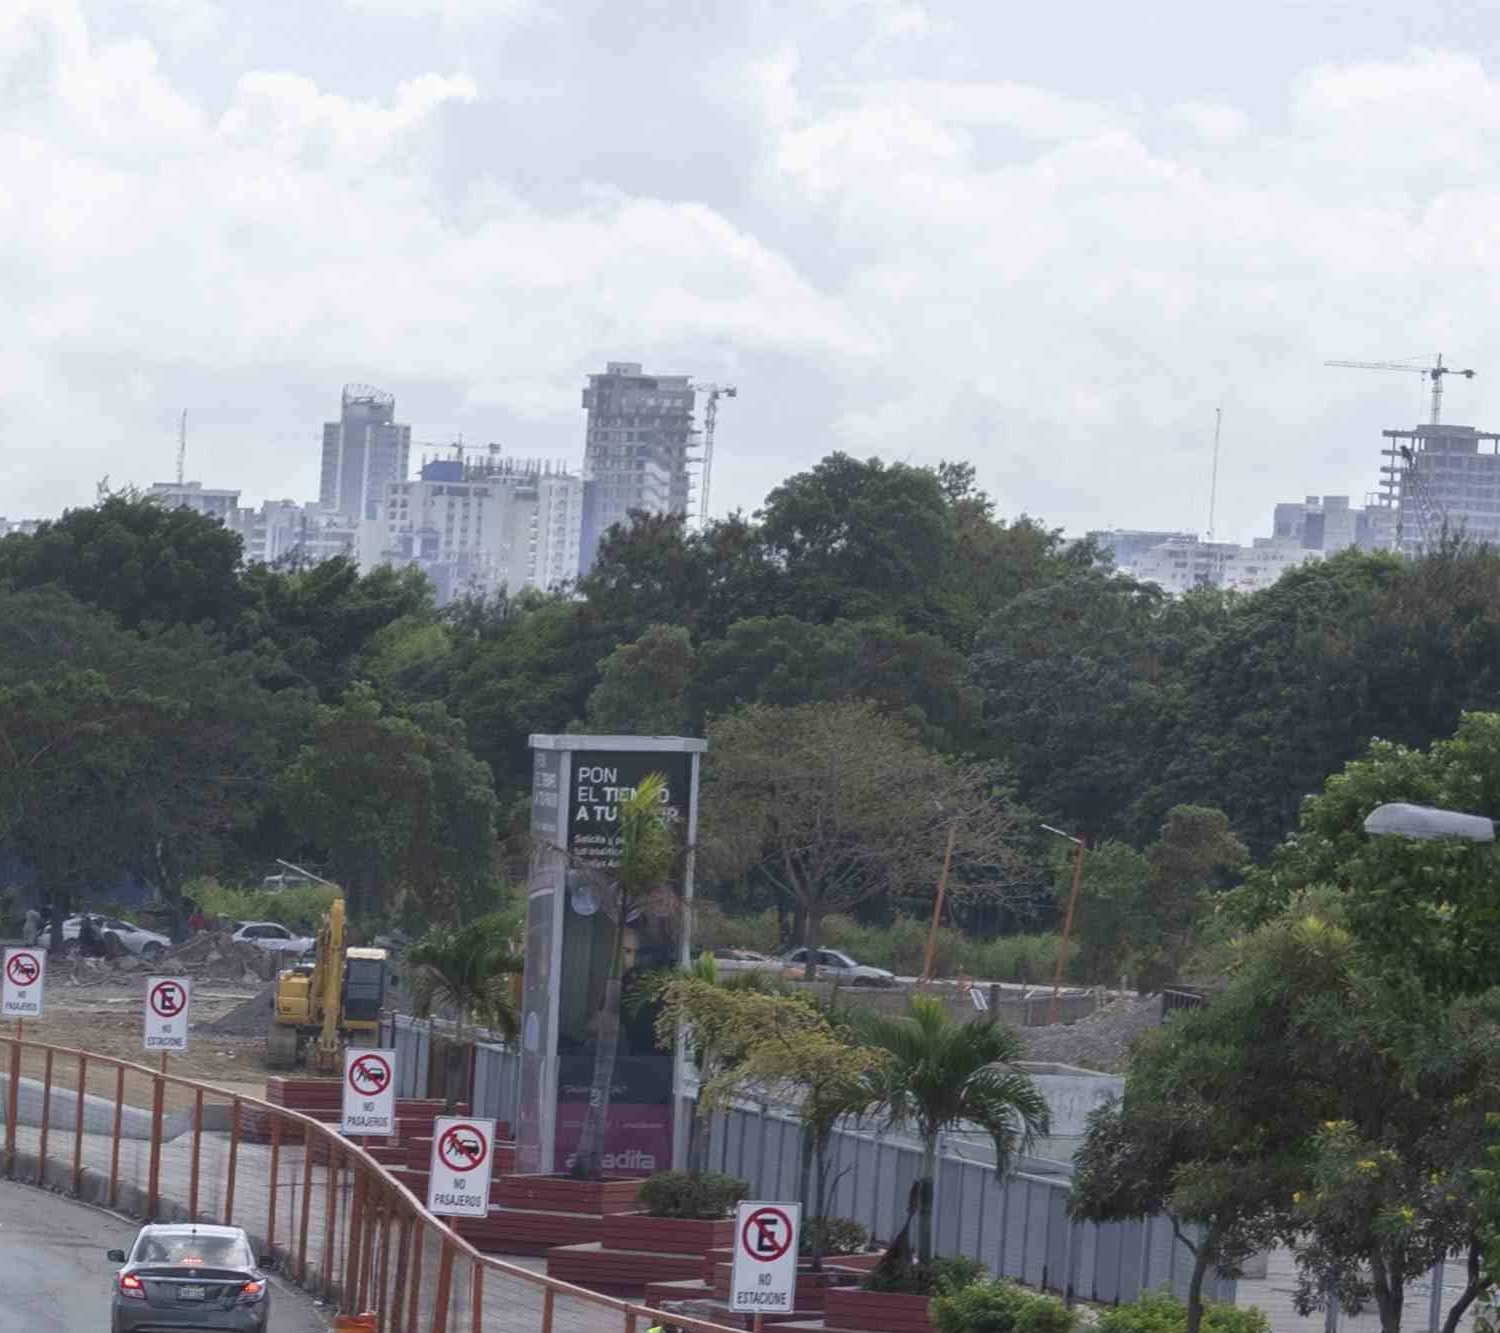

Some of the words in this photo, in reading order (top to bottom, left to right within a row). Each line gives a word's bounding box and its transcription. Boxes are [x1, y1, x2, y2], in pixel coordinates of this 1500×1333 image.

[578, 767, 618, 784] PON
[577, 786, 599, 802] EL
[575, 806, 589, 821] A
[594, 806, 617, 822] TU
[363, 1101, 375, 1112] NO
[347, 1116, 389, 1128] PASAJEROS
[452, 1178, 466, 1190] NO
[434, 1192, 482, 1208] PASAJEROS
[758, 1272, 772, 1286] NO
[736, 1291, 787, 1305] ESTACIONE
